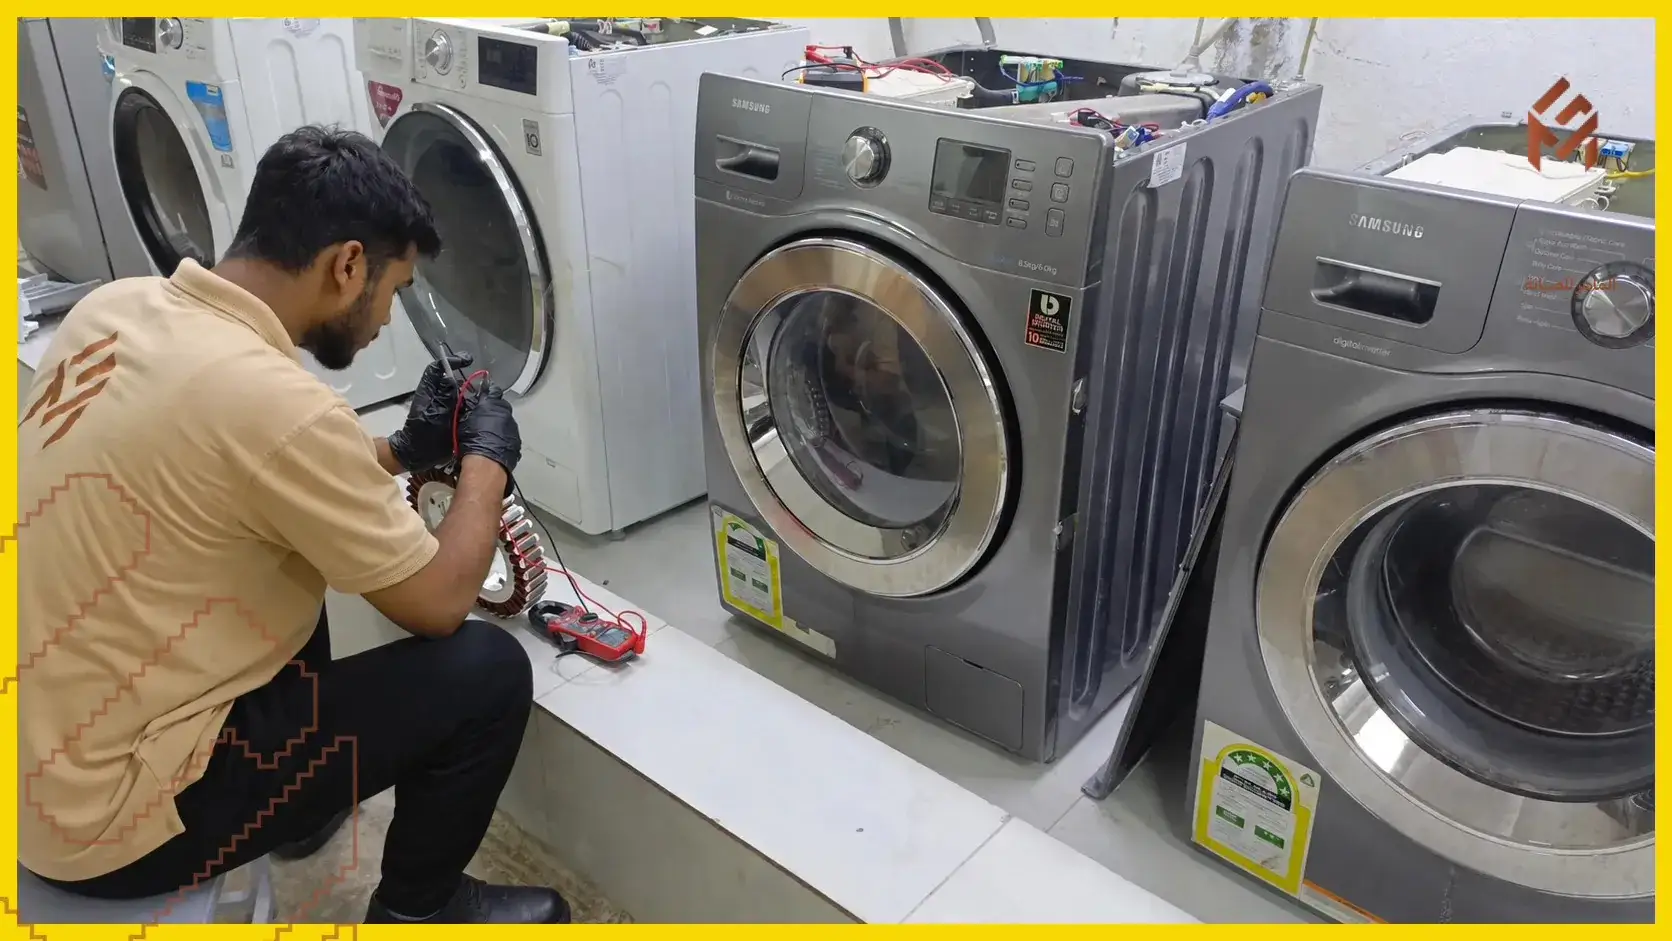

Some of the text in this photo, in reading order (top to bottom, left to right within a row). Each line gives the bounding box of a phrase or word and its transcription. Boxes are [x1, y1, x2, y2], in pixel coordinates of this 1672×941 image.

[732, 98, 771, 114] SAMSUNG
[1349, 213, 1424, 239] SAMSUNG
[1028, 331, 1040, 343] 10
